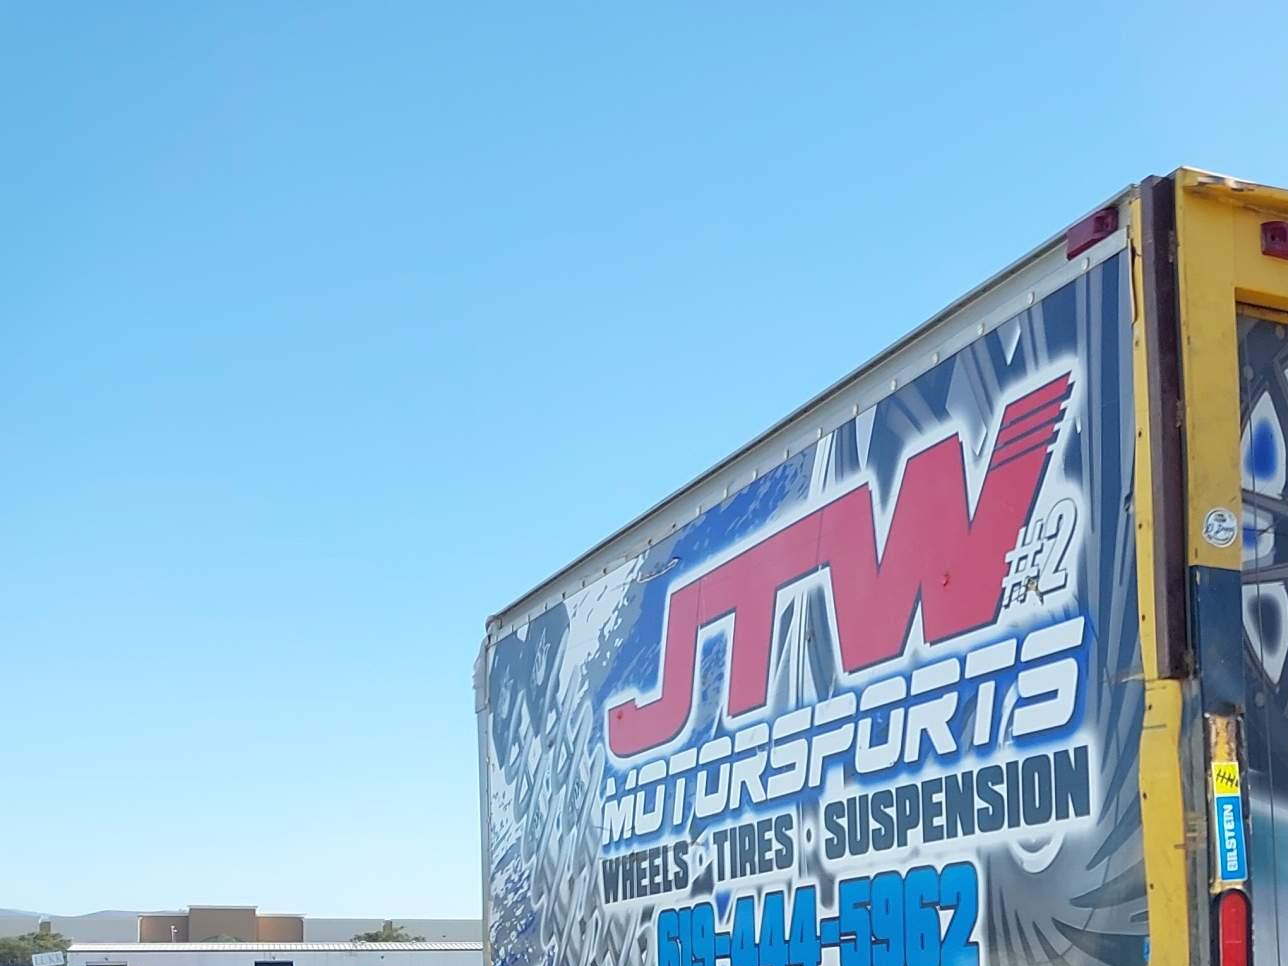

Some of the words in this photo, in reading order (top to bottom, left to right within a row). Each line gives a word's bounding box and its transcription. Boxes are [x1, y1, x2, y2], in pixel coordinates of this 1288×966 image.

[608, 370, 1072, 757] JTW
[602, 847, 689, 904] WHEELS
[713, 814, 793, 883] TIRES
[824, 746, 1090, 860] SUSPENSION
[603, 617, 1086, 846] MOTORSPORTS
[1223, 804, 1238, 871] BILSTEIN
